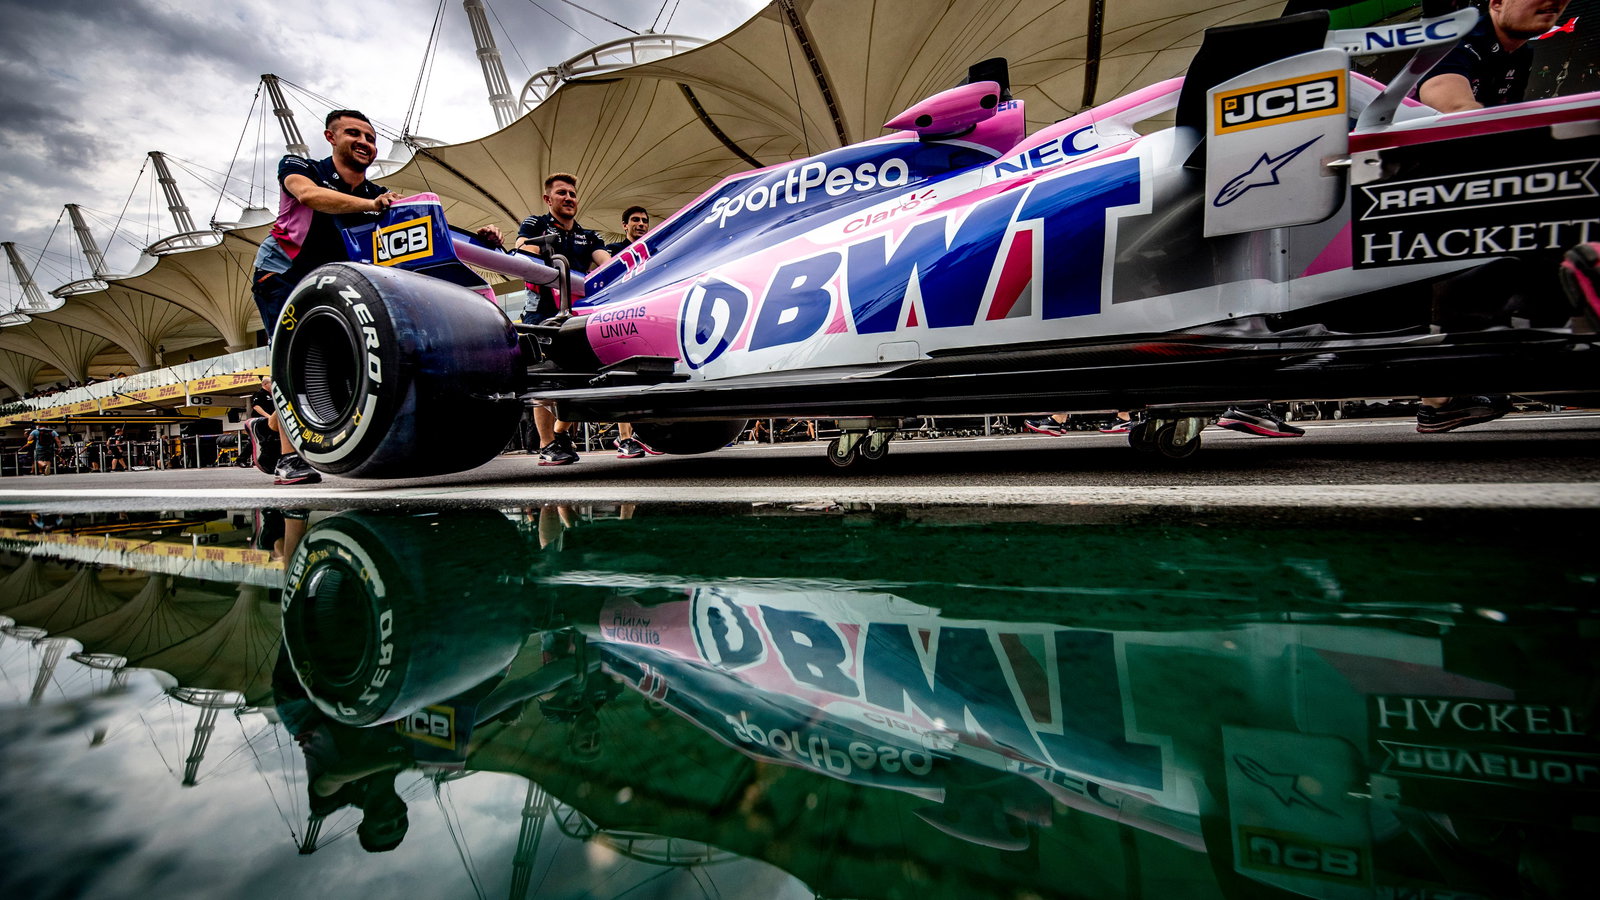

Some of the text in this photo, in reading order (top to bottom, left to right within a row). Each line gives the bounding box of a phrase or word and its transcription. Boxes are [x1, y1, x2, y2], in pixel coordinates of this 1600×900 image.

[1366, 18, 1457, 51] NEC
[997, 100, 1018, 113] ER
[1224, 81, 1336, 125] JCB
[993, 125, 1099, 178] NEC
[1379, 169, 1583, 210] RAVENOL
[378, 226, 428, 260] JCB
[748, 157, 1140, 352] BWT
[1360, 218, 1600, 264] HACKETT
[618, 241, 651, 283] 11
[316, 276, 383, 384] P ZERO
[590, 305, 646, 325] Acronis
[599, 321, 639, 339] UNIVA
[190, 396, 213, 406] 08
